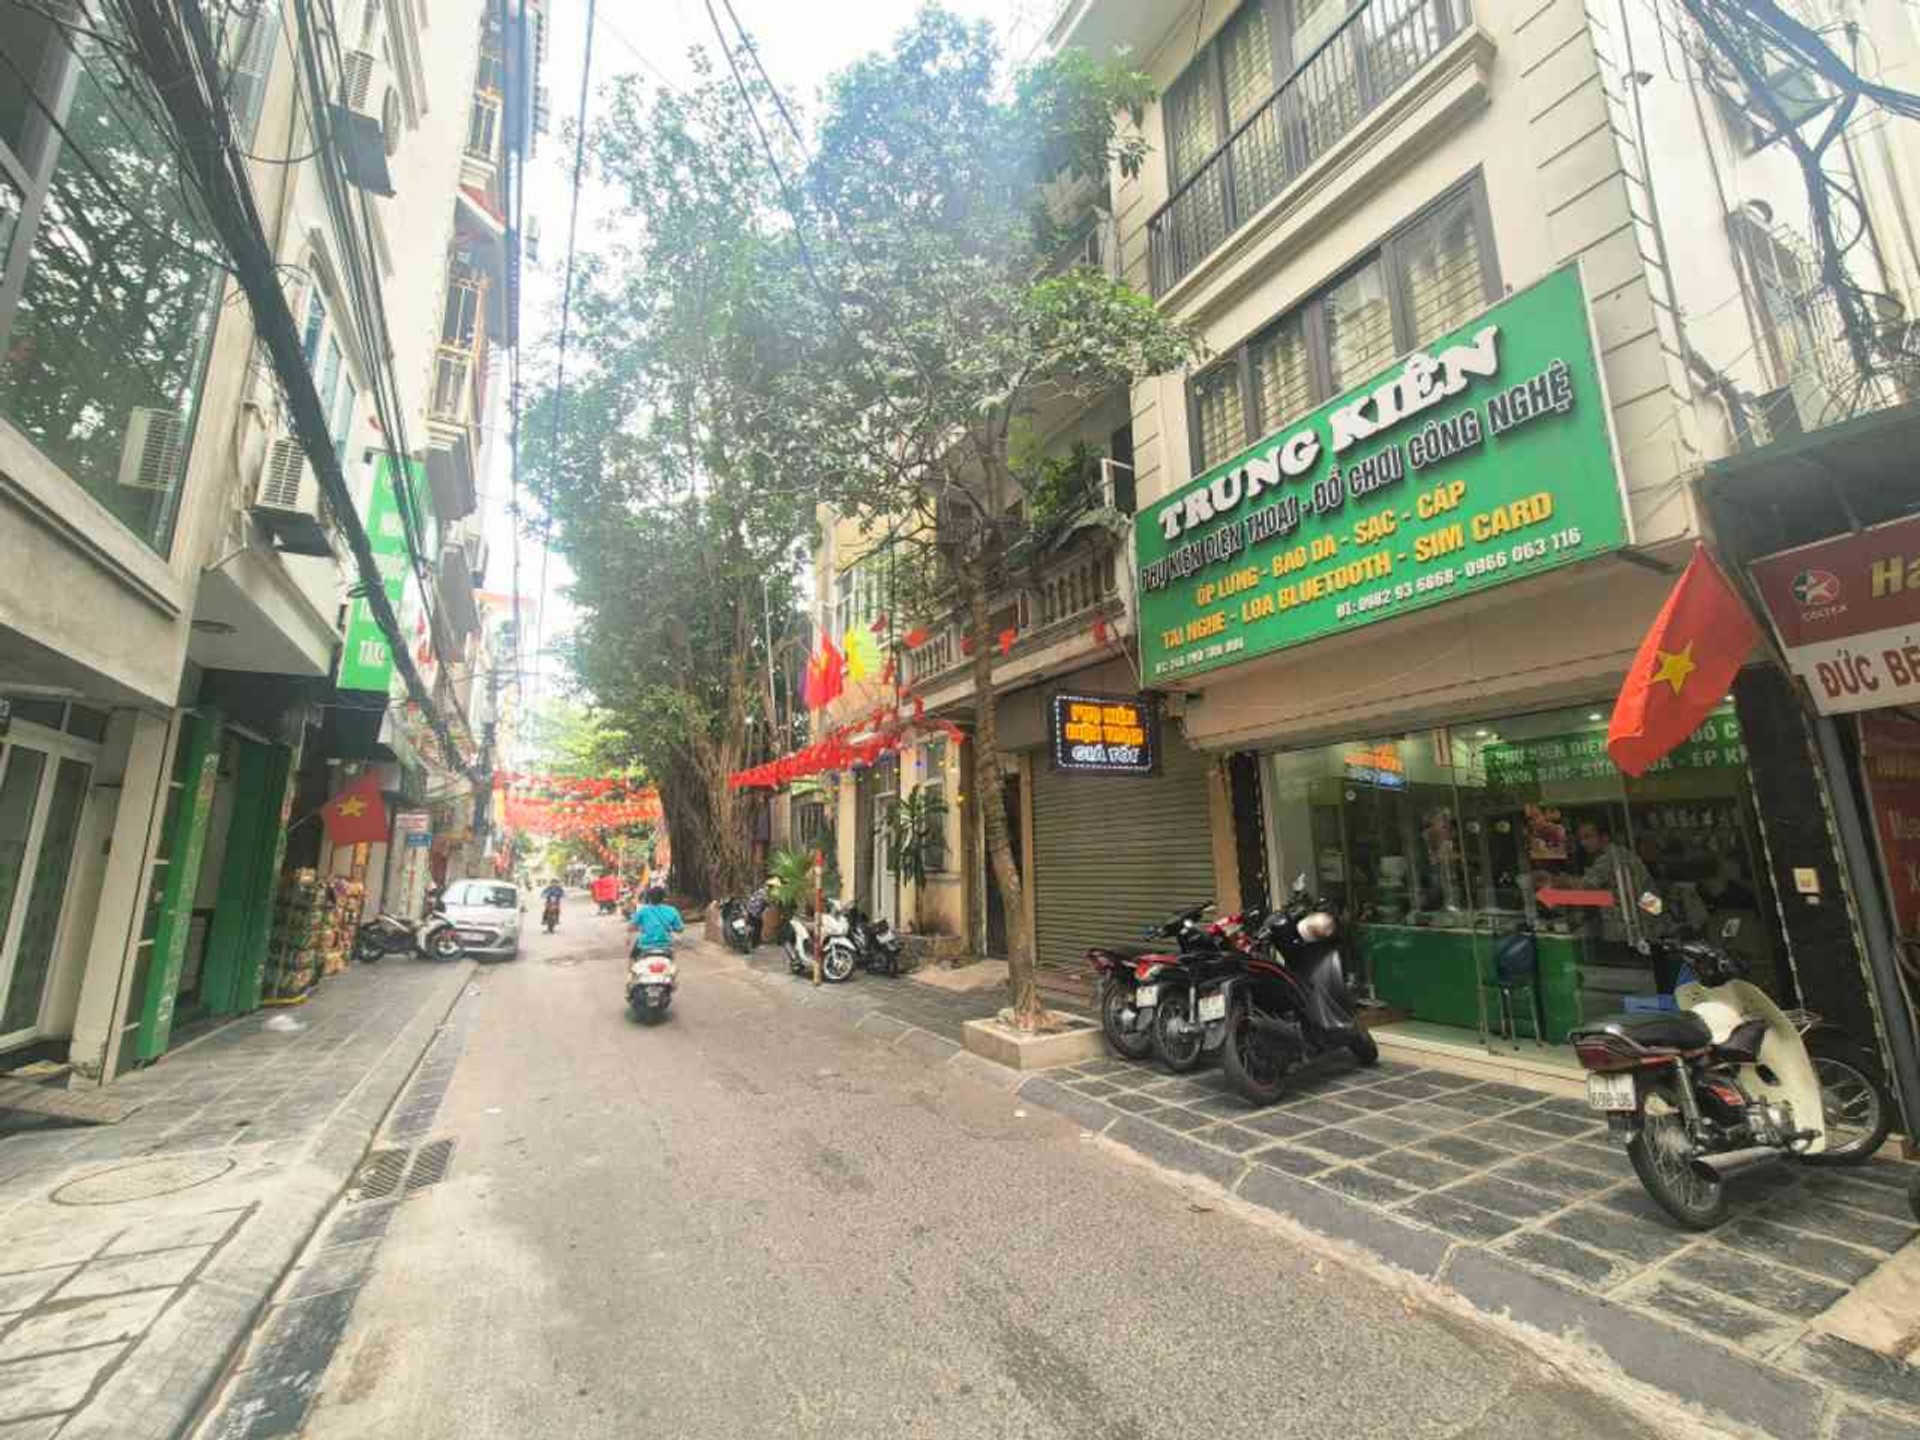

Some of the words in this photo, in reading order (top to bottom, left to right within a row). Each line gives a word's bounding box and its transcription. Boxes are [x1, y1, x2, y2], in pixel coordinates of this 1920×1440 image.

[1158, 429, 1319, 540] TRUNG
[1328, 325, 1499, 452] KIÊN
[1350, 442, 1405, 497] CHƠI
[1408, 407, 1480, 470] CÔNG
[1487, 358, 1573, 434] NGHỆ
[1242, 594, 1274, 624] LOA
[1277, 550, 1393, 611] BLUETOOTH
[1414, 524, 1465, 562] SIM
[1470, 492, 1555, 542] CARD
[1272, 546, 1308, 578] BAO
[1311, 534, 1337, 561] DA
[1354, 509, 1397, 547] SẠC
[1417, 480, 1466, 519] CÁP
[1394, 583, 1413, 601] 93
[1464, 551, 1508, 578] 0966
[1511, 542, 1547, 563] 063
[1551, 527, 1582, 550] 116
[1815, 649, 1879, 697] ĐỨC
